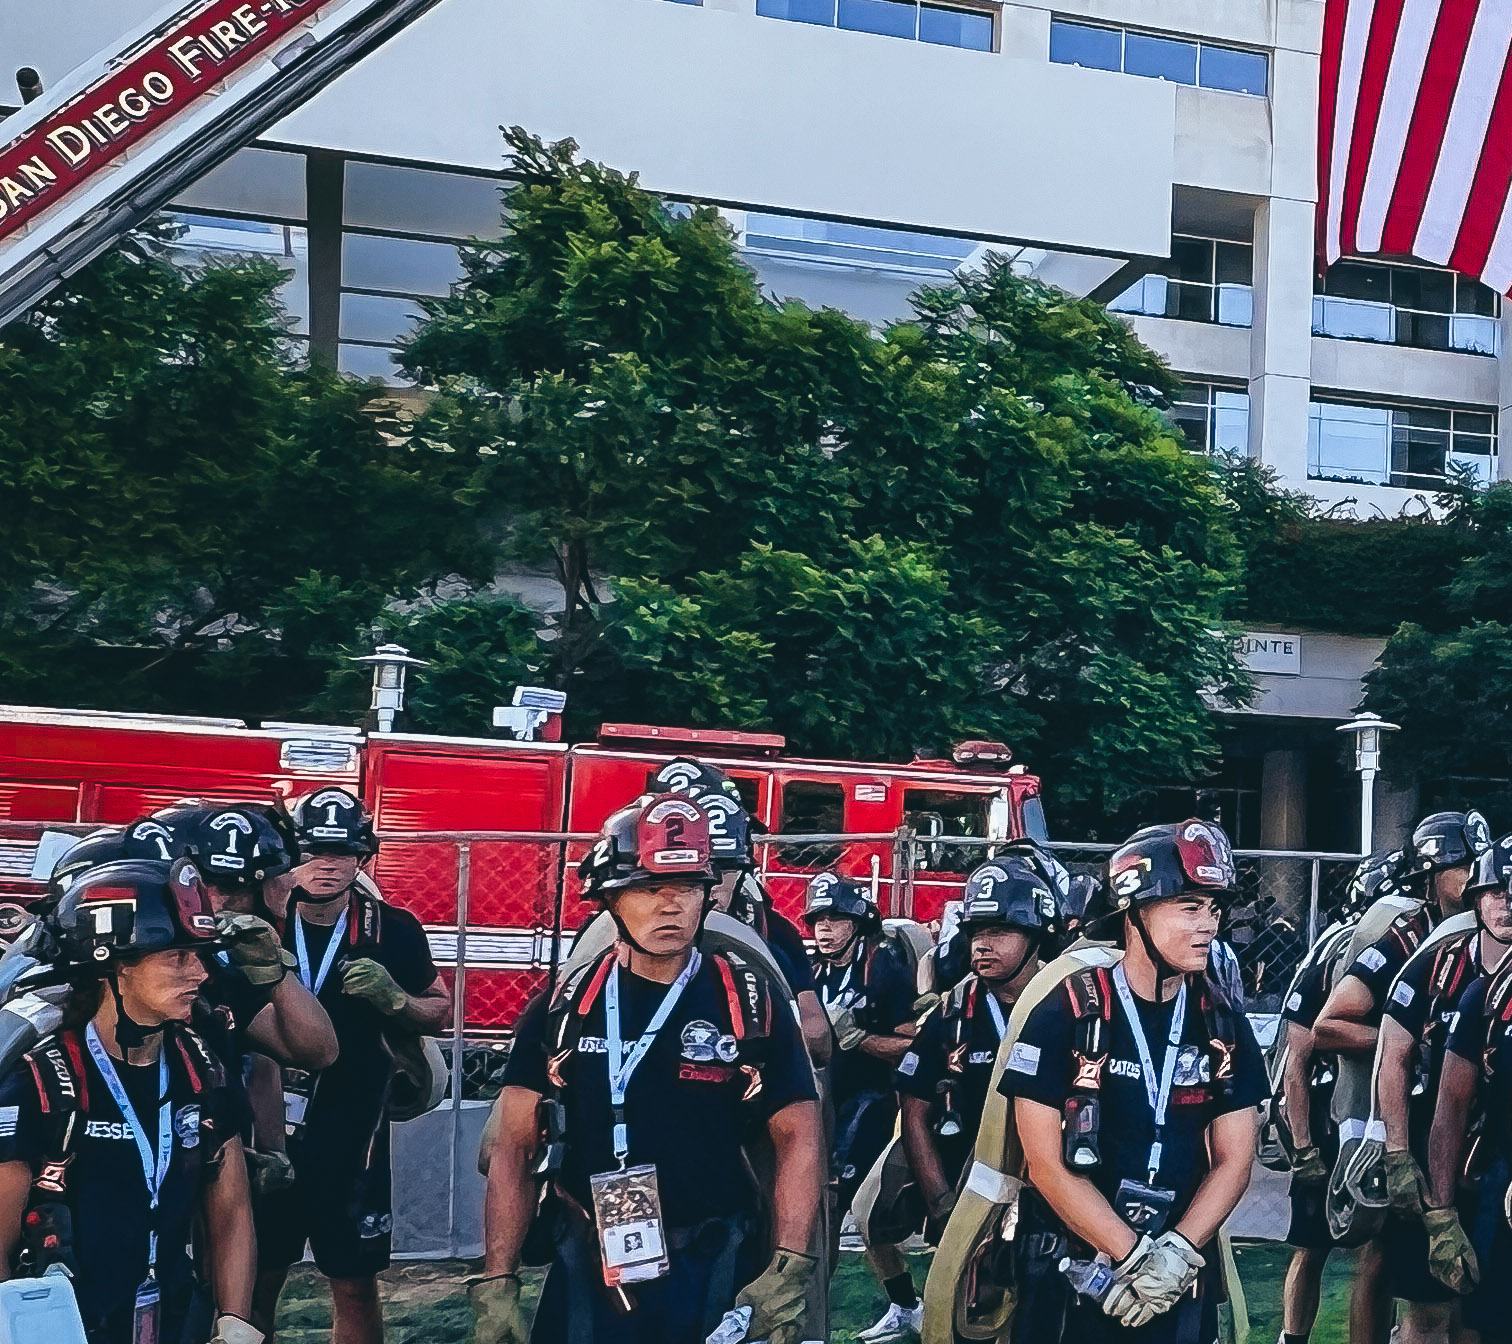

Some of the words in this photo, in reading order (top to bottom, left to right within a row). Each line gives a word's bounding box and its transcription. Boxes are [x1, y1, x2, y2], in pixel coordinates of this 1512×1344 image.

[46, 71, 175, 166] DIEGO
[324, 805, 337, 825] 1
[708, 809, 727, 835] 2
[227, 828, 238, 854] 1
[666, 817, 687, 847] 2
[592, 839, 609, 866] 2
[1420, 838, 1441, 856] 4
[814, 881, 829, 896] 2
[976, 877, 994, 898] 3
[1114, 869, 1142, 895] 3
[89, 906, 114, 934] 1
